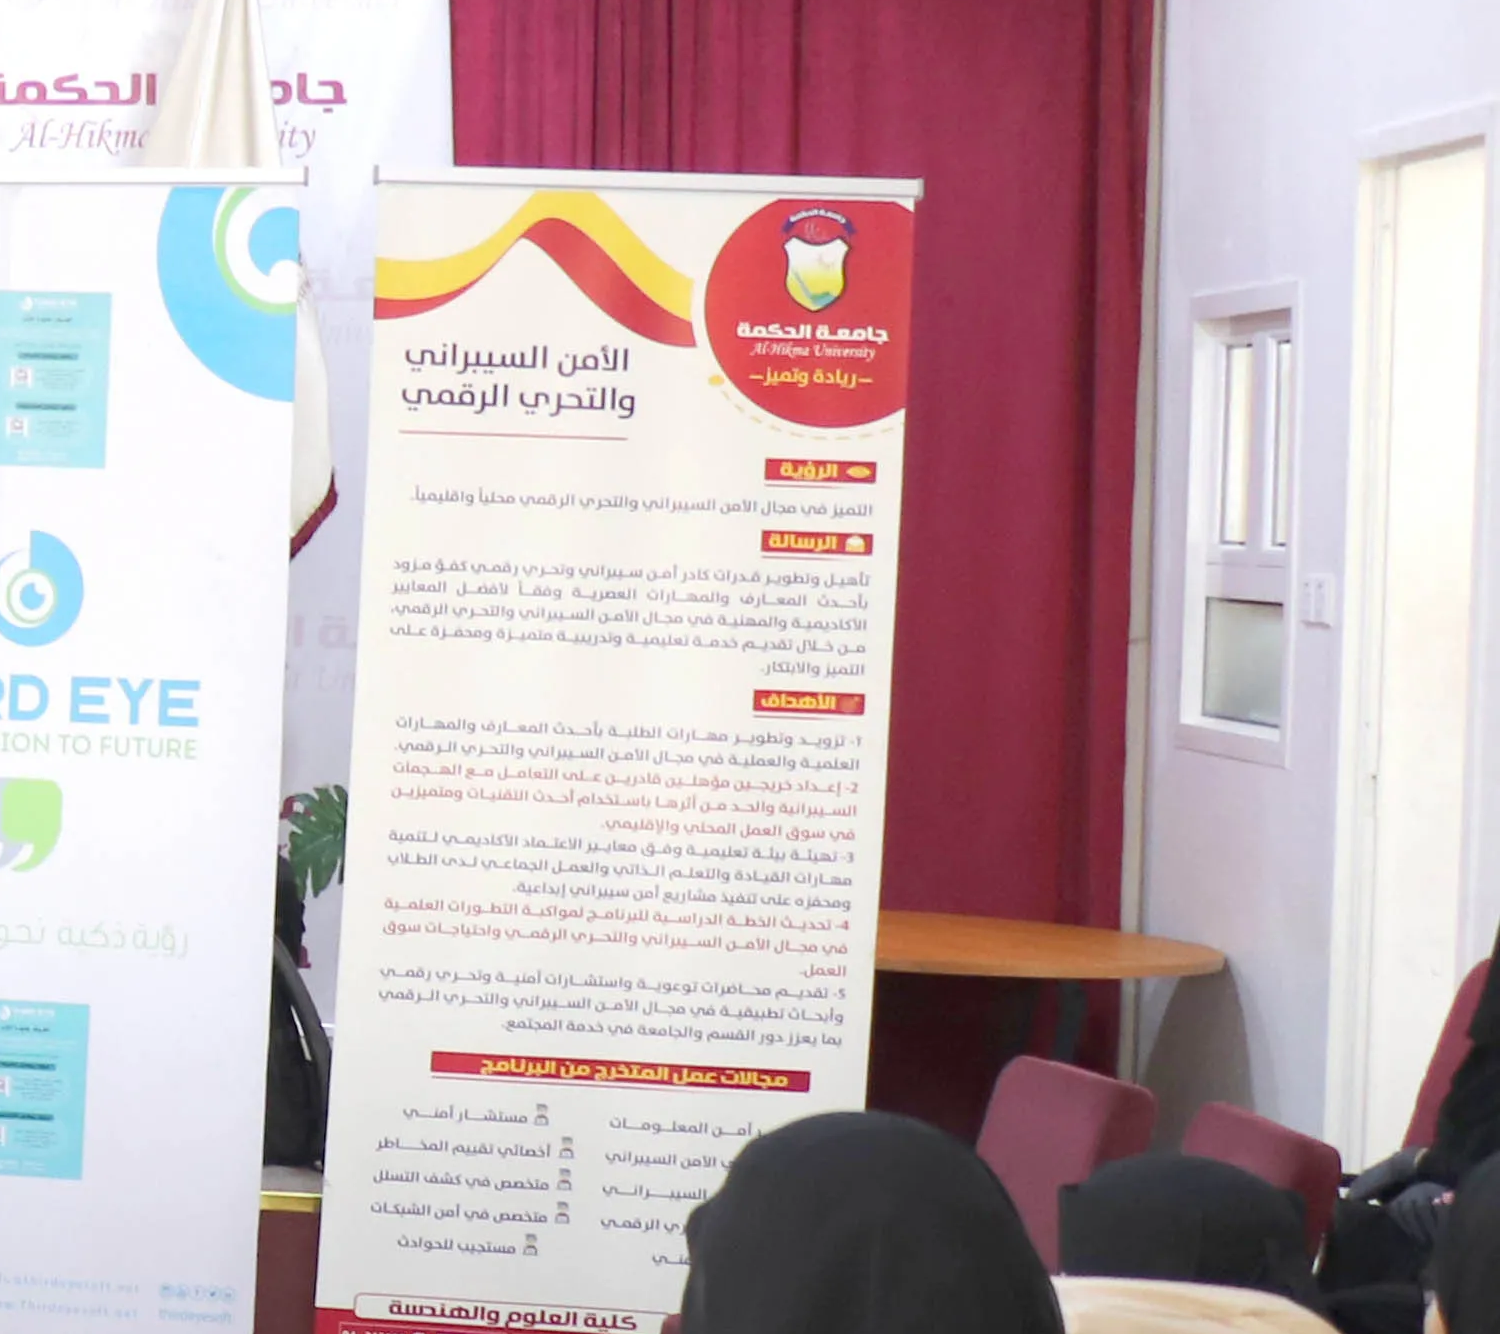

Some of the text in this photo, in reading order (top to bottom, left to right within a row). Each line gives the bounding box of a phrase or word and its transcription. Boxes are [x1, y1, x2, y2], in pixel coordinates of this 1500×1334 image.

[735, 320, 892, 346] جامعة الحكمة
[404, 341, 630, 377] الأمن السيبراني
[813, 342, 877, 363] University
[401, 382, 636, 420] والتحري الرقمي
[779, 461, 839, 481] الرؤية
[519, 493, 576, 510] الرقمي
[579, 493, 639, 512] والتحري
[641, 497, 717, 515] السيبراني
[760, 501, 798, 518] مجال
[800, 504, 828, 517] في
[829, 503, 874, 520] التميز
[768, 533, 839, 552] الرسالة
[69, 676, 201, 728] EYE
[760, 692, 838, 712] الأهداف
[59, 733, 93, 757] TO
[100, 734, 200, 762] FUTURE
[56, 918, 127, 956] ذكية
[131, 920, 189, 960] رؤية
[480, 1057, 791, 1088] مجالات عمل المتخرج من البرنامج
[402, 1104, 529, 1125] مستشار أمني
[375, 1135, 449, 1154] المخاطر
[451, 1143, 494, 1157] تقييم
[369, 1200, 549, 1225] متخصص في أمن الشبكات
[388, 1299, 638, 1333] كلية العلوم والهندسة
